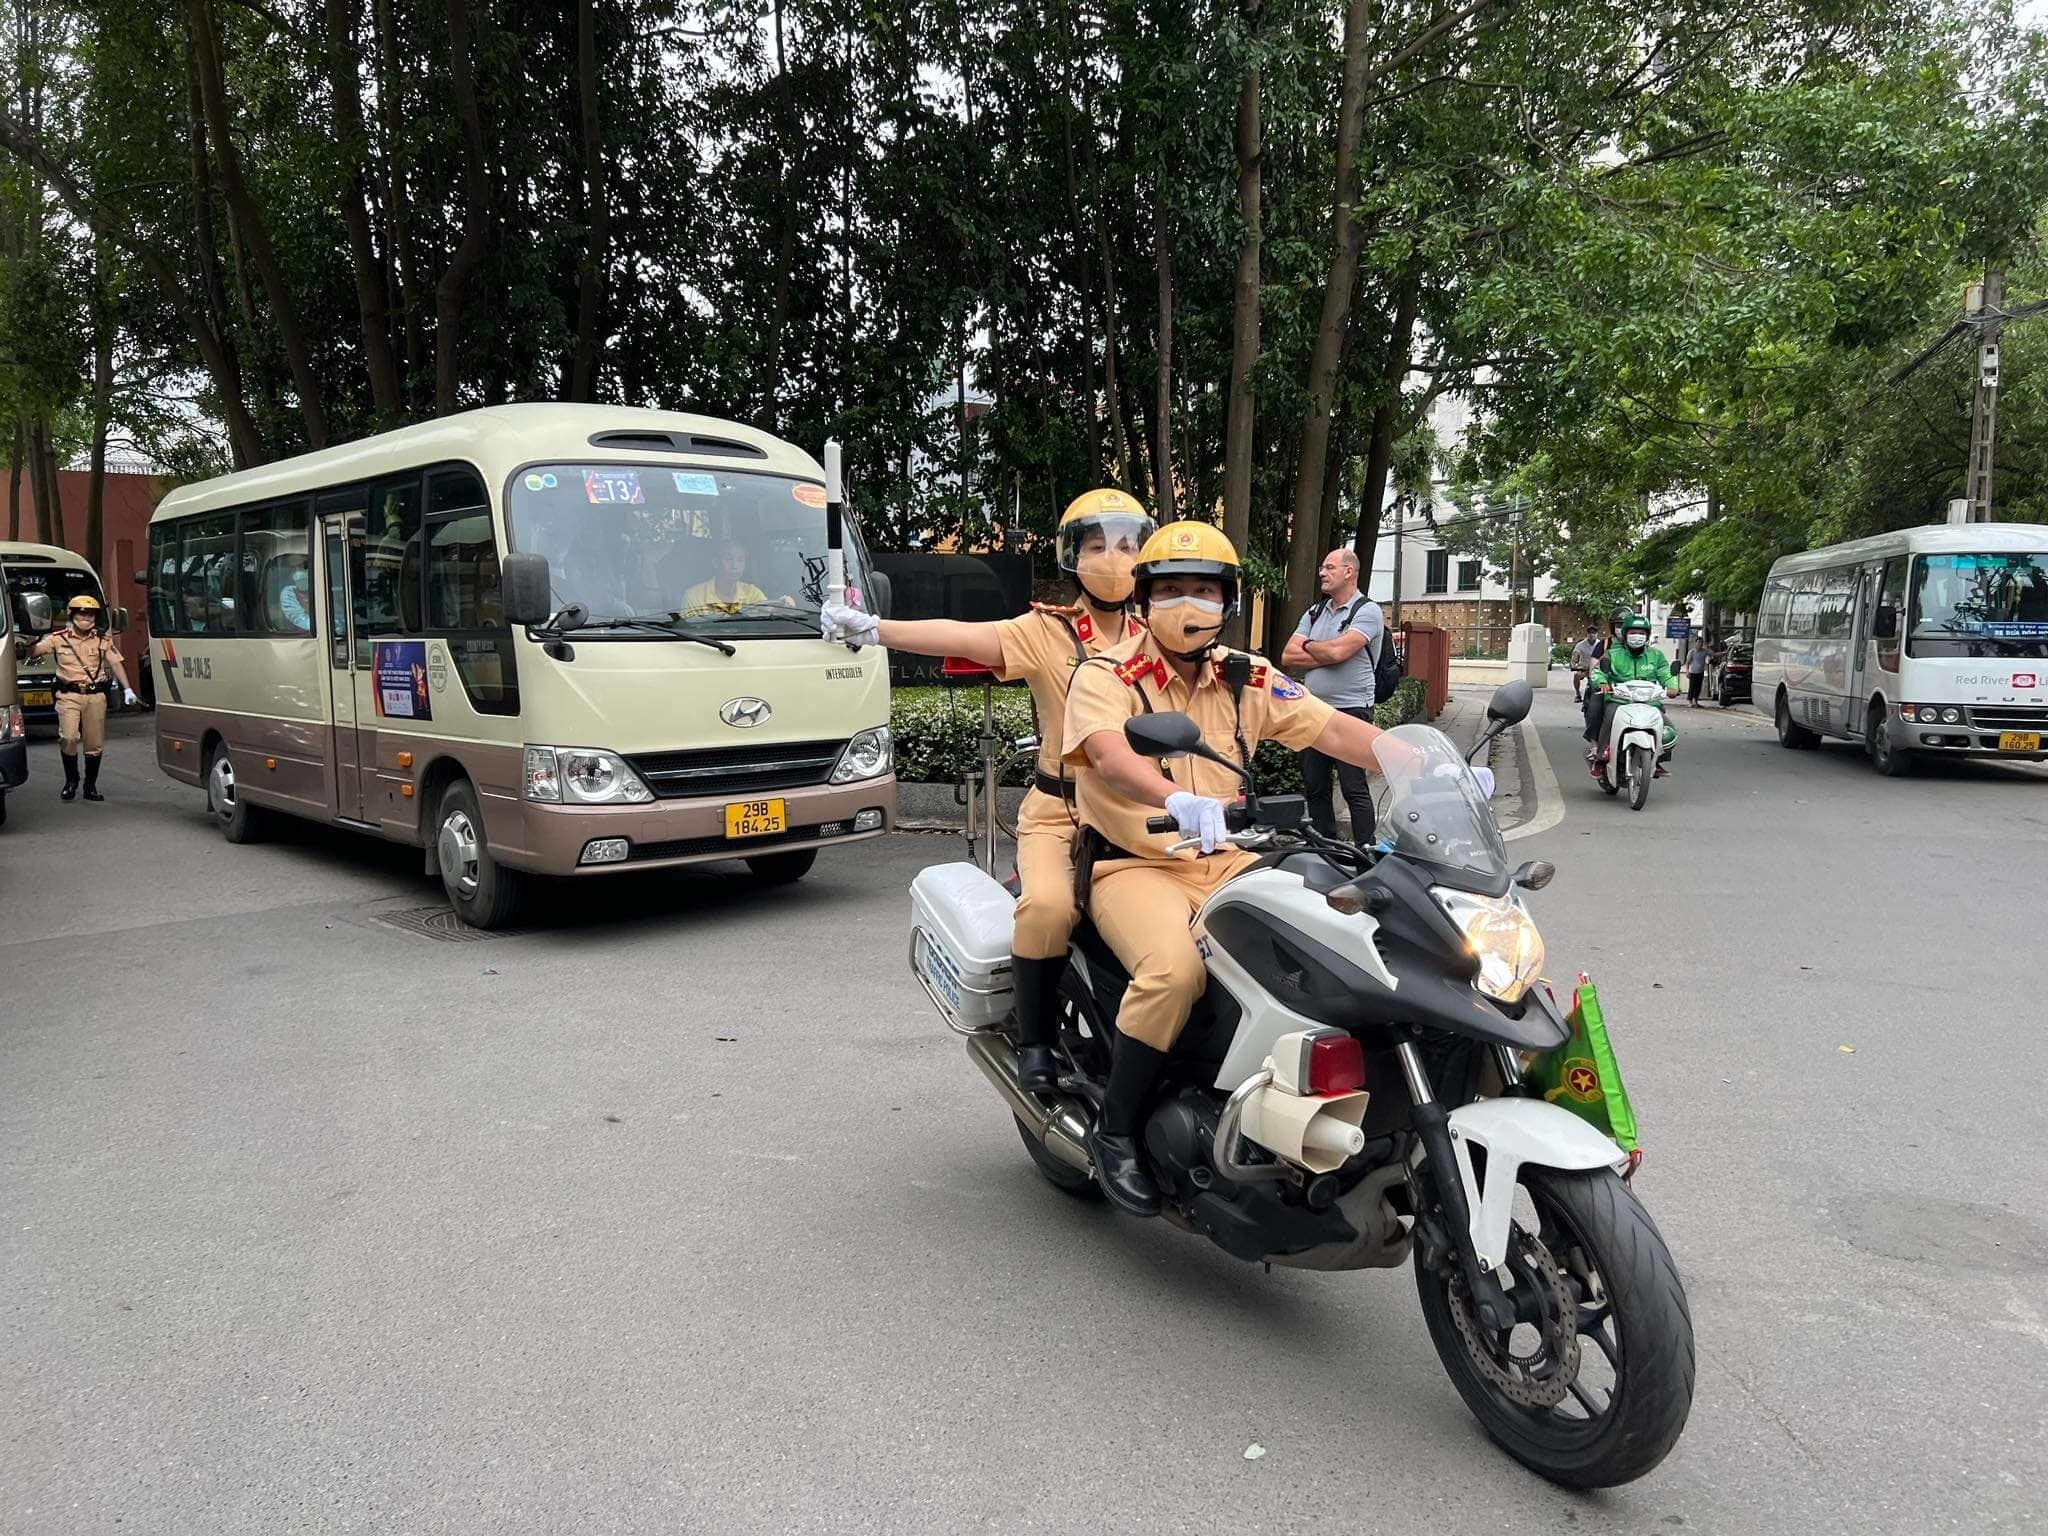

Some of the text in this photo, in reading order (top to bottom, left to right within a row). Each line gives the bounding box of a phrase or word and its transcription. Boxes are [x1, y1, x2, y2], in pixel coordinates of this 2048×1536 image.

[604, 479, 630, 501] T3
[824, 666, 864, 680] INTERCOOLER
[1955, 675, 1978, 685] Red
[1980, 675, 2010, 685] River
[743, 802, 769, 818] 29B
[734, 817, 780, 835] 184.25
